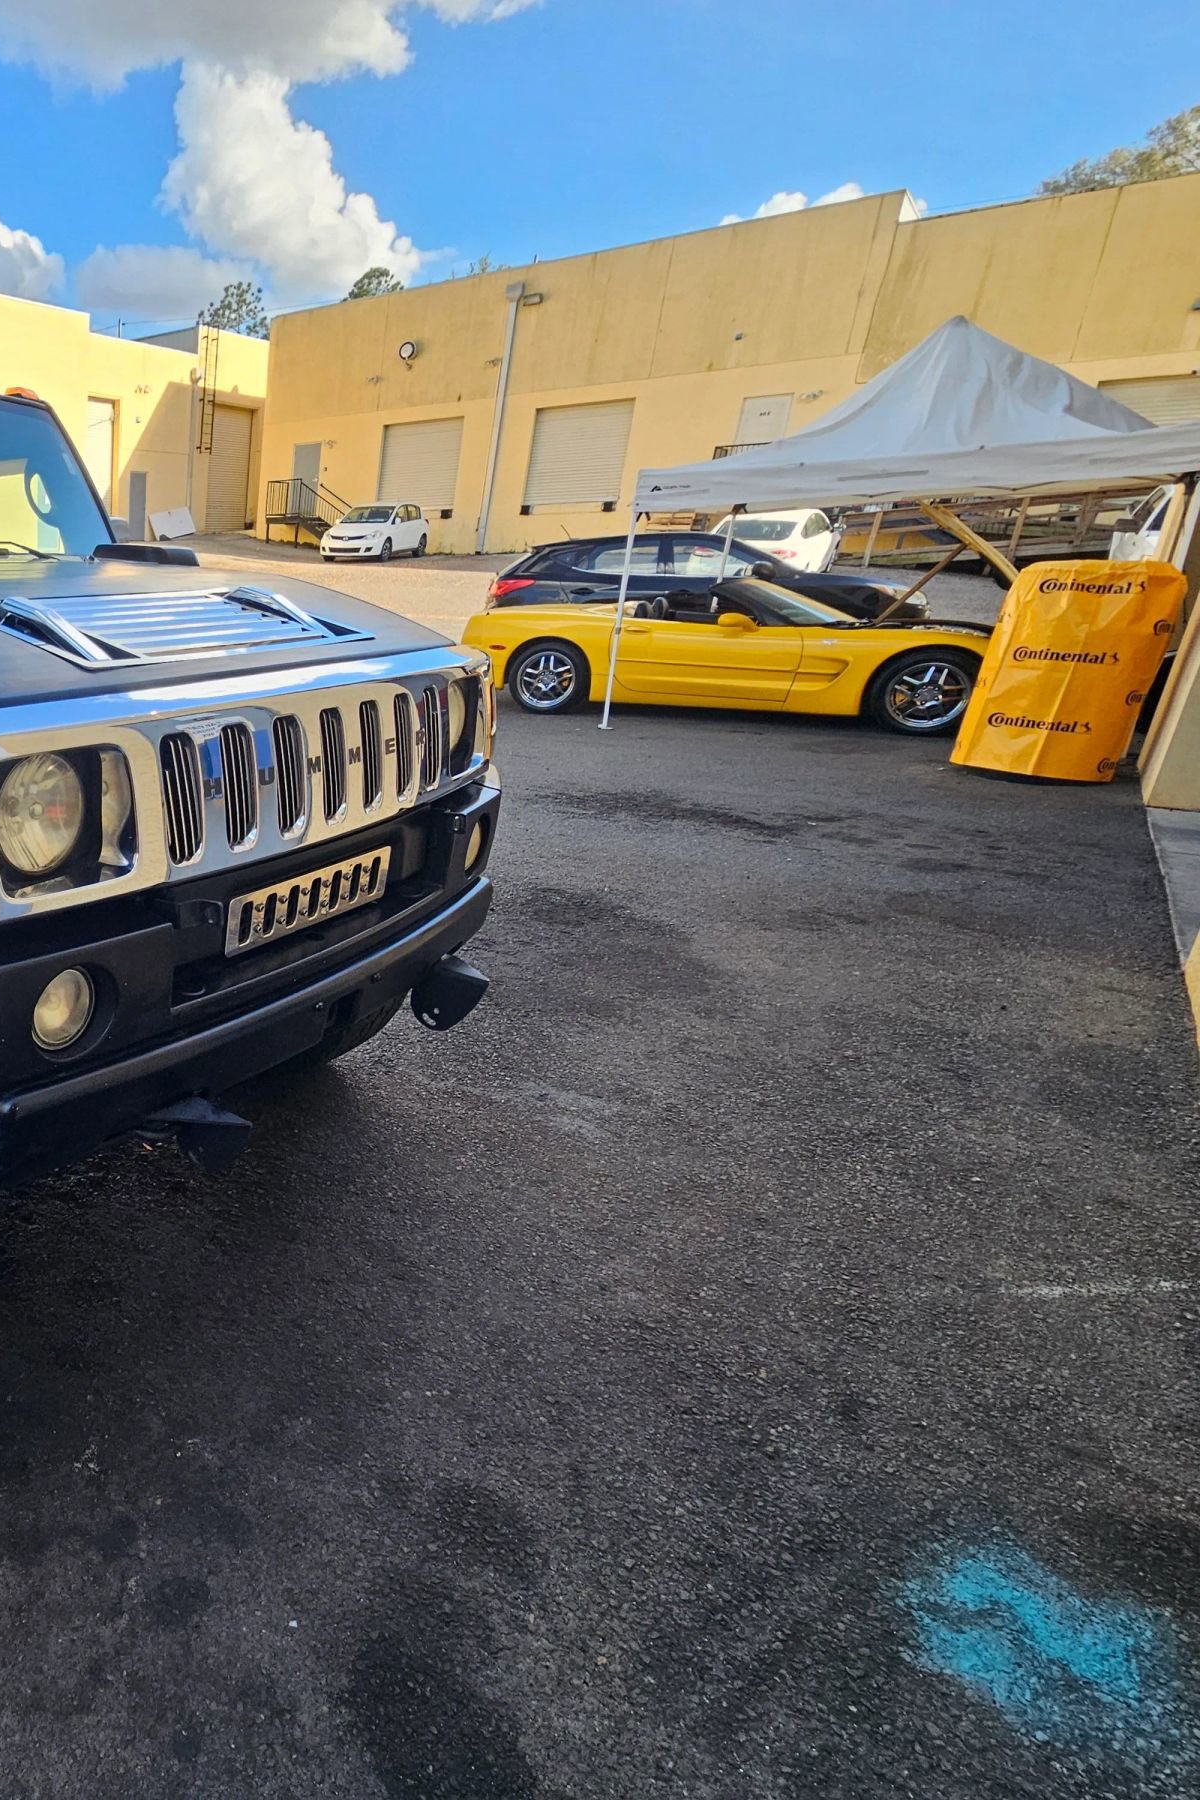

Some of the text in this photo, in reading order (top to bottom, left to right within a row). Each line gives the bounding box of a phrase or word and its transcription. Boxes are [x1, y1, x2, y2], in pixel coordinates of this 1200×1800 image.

[1039, 578, 1132, 594] Coninental
[1013, 646, 1107, 664] Continental
[987, 712, 1078, 733] Continental
[203, 727, 426, 798] HUMMER
